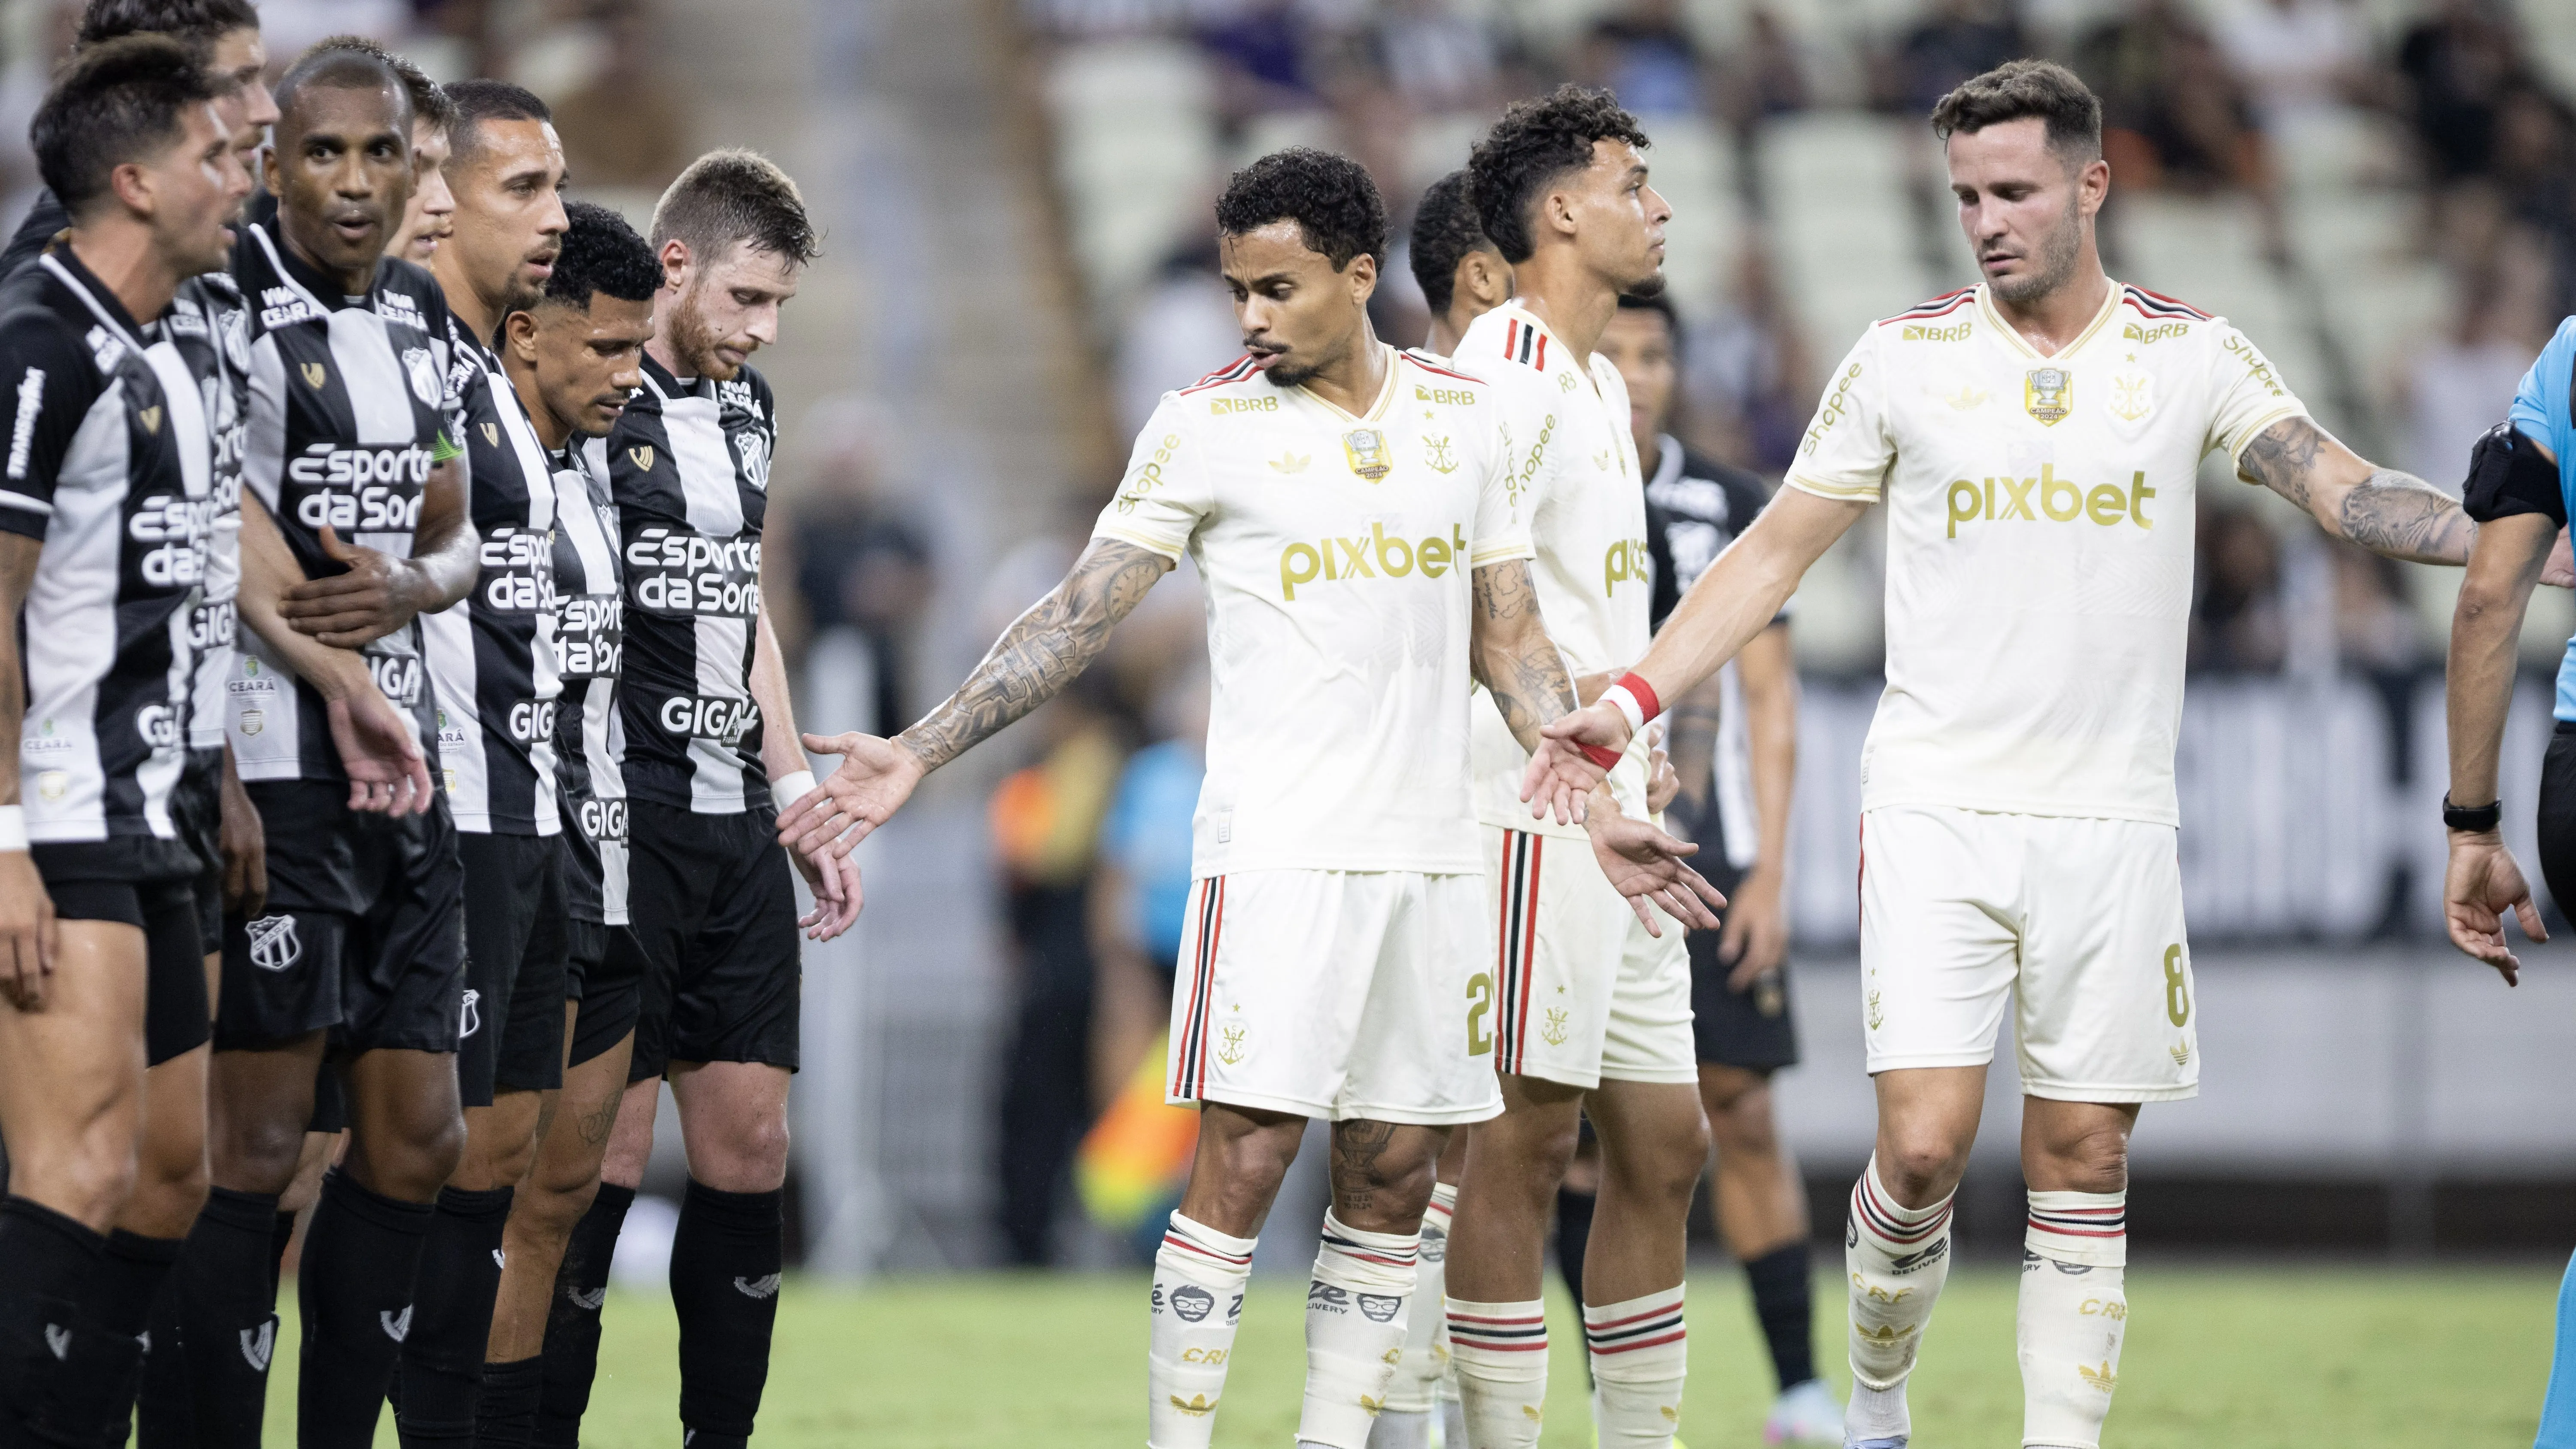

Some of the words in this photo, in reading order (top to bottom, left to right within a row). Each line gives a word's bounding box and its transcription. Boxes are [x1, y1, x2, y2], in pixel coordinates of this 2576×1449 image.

[1928, 322, 1972, 342] BRB
[2144, 323, 2189, 344] BRB
[2223, 335, 2284, 397] Shopee
[1234, 396, 1279, 412] BRB
[1433, 389, 1476, 405] BRB
[1803, 362, 1862, 456] Shopee
[1118, 433, 1181, 516] Shopee
[360, 486, 424, 529] Sor
[1947, 463, 2156, 539] pixbet
[627, 528, 761, 578] Esporte
[1279, 521, 1467, 601] pixbet
[228, 678, 276, 692] CEARÁ
[438, 729, 465, 742] ARÁ
[509, 701, 554, 739] GIG
[2164, 943, 2190, 1027] 8
